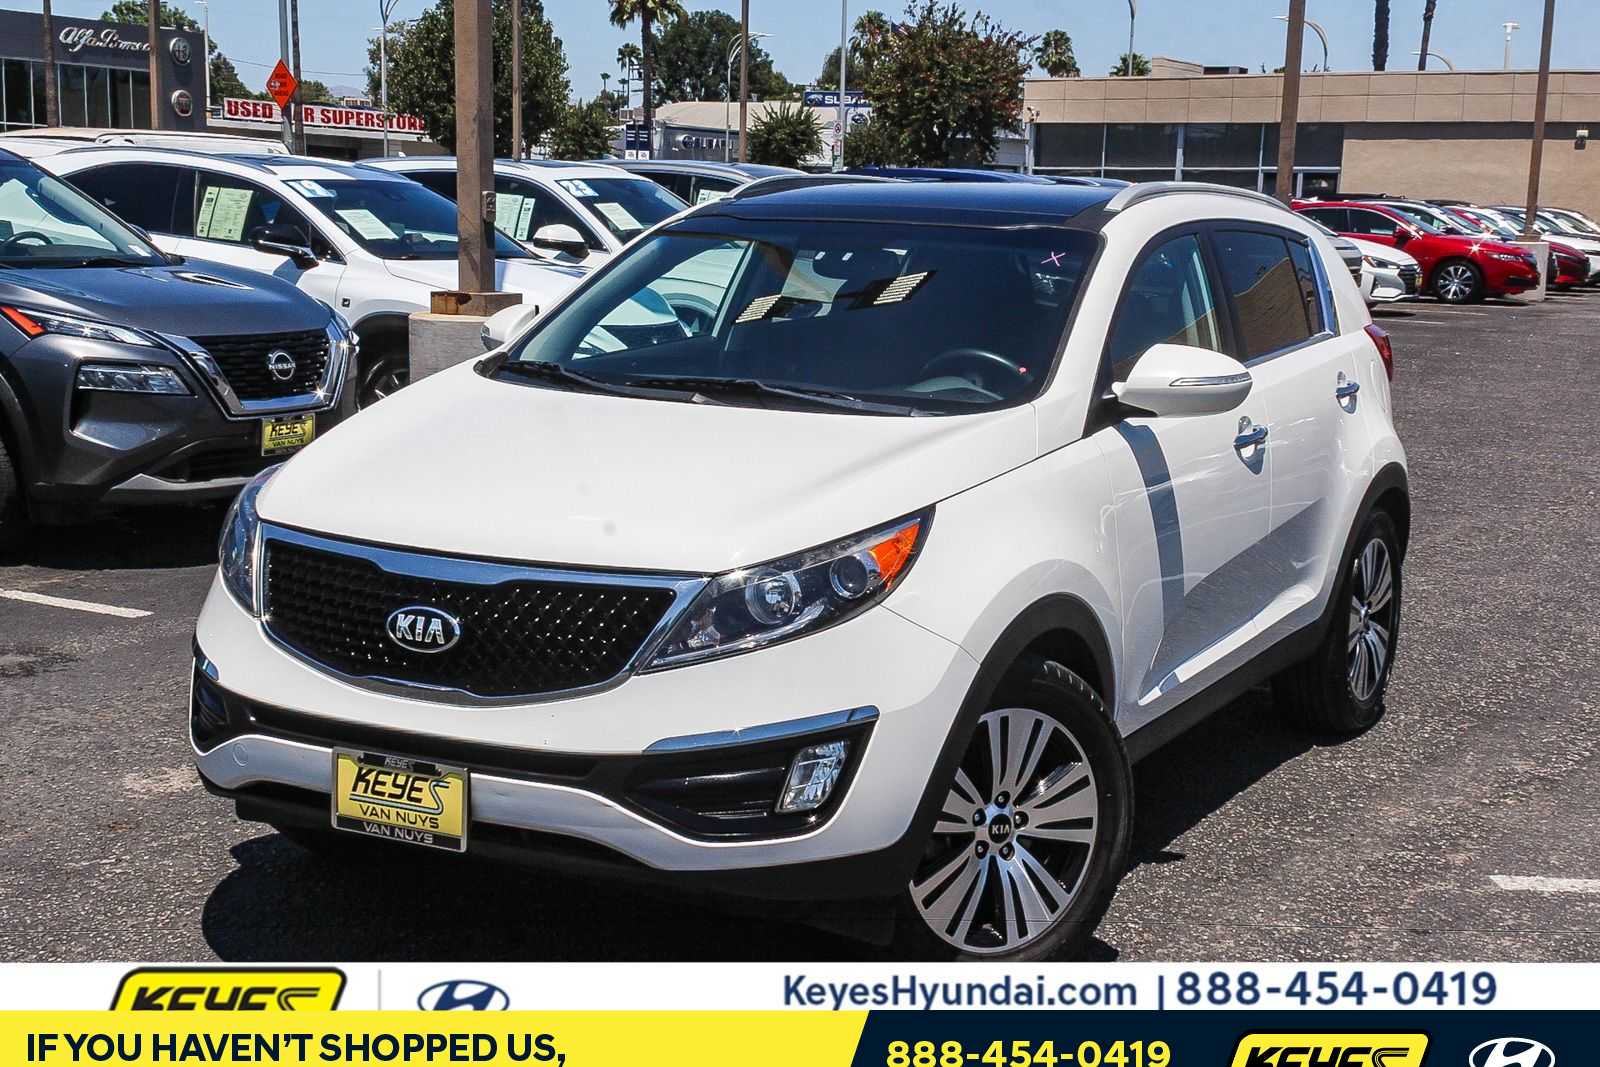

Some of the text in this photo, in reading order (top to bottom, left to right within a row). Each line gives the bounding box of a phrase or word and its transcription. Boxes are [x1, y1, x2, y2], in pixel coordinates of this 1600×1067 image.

[59, 27, 99, 51] Alfa
[227, 100, 273, 119] USED
[269, 362, 296, 370] NISSAN
[396, 614, 445, 644] KIA
[384, 757, 415, 769] KEYES
[351, 766, 451, 813] KEYES
[360, 804, 439, 829] VAN NUYS
[363, 821, 433, 843] VAN NUYS
[991, 824, 1010, 834] KIA
